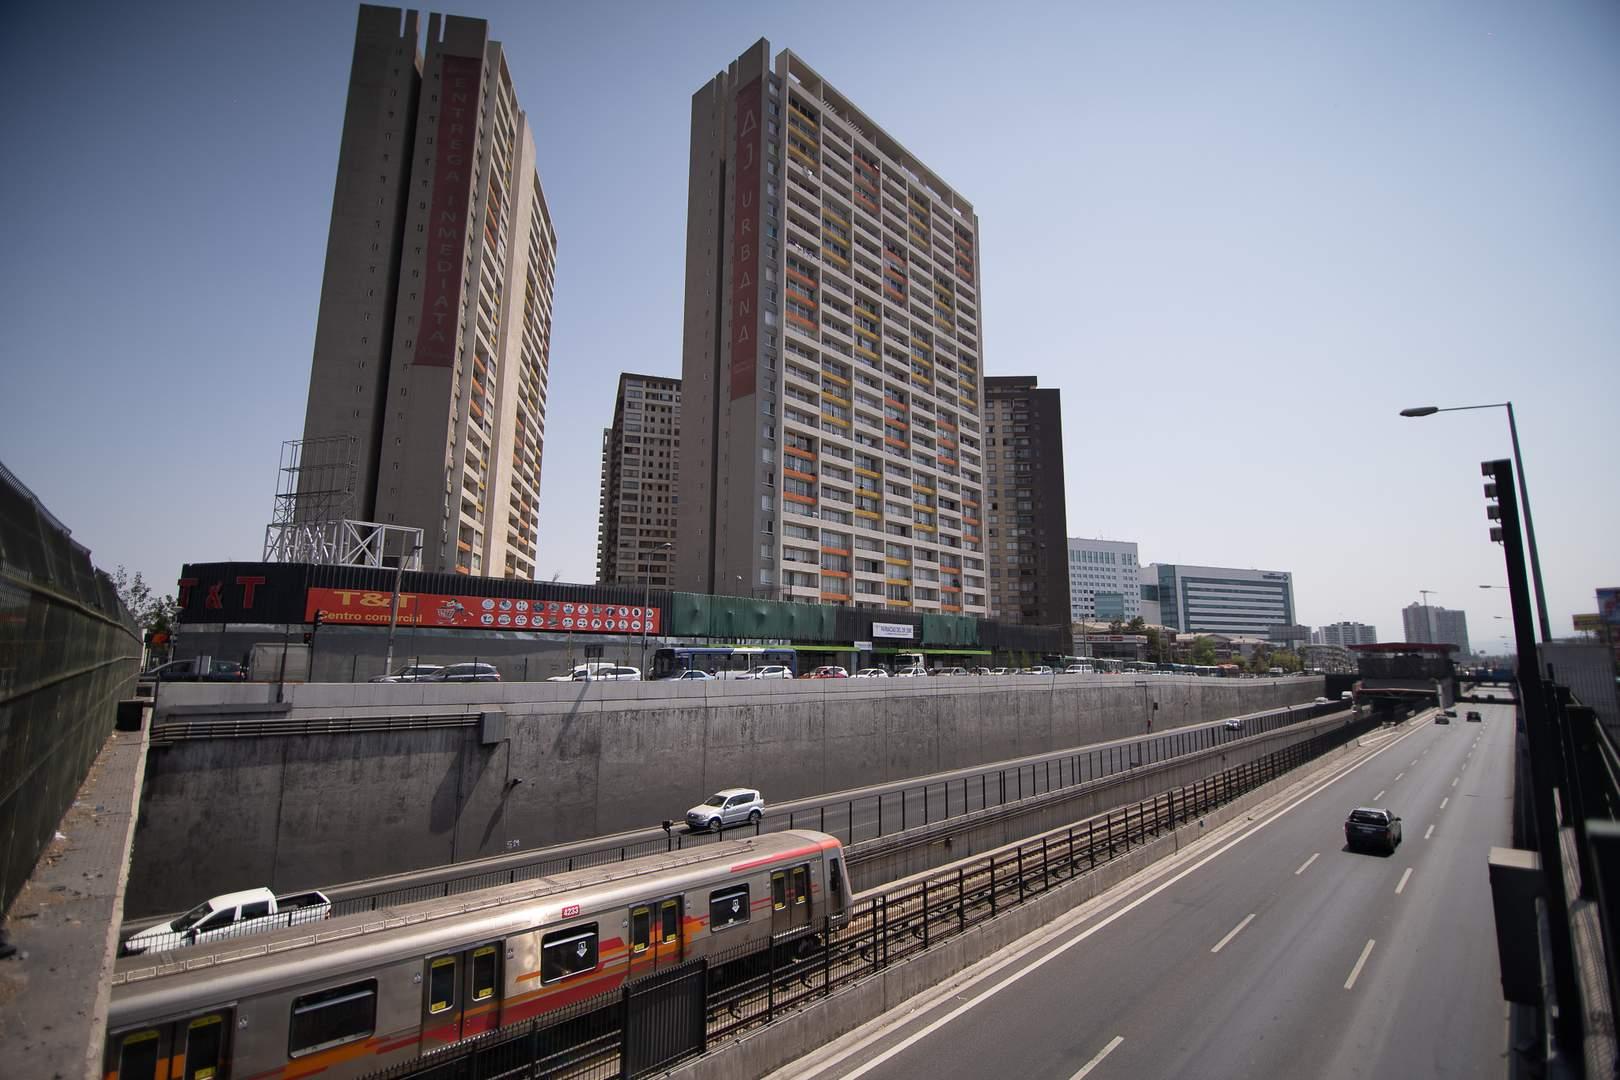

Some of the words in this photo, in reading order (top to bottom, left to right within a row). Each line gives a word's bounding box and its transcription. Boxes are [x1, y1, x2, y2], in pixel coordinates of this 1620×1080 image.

[446, 78, 467, 182] ENTREGA
[430, 194, 458, 343] INMEDIATA
[737, 191, 752, 343] URBANA
[319, 610, 362, 621] Centro
[365, 613, 423, 623] comrcial
[333, 591, 417, 608] T&T
[563, 905, 579, 917] 4233
